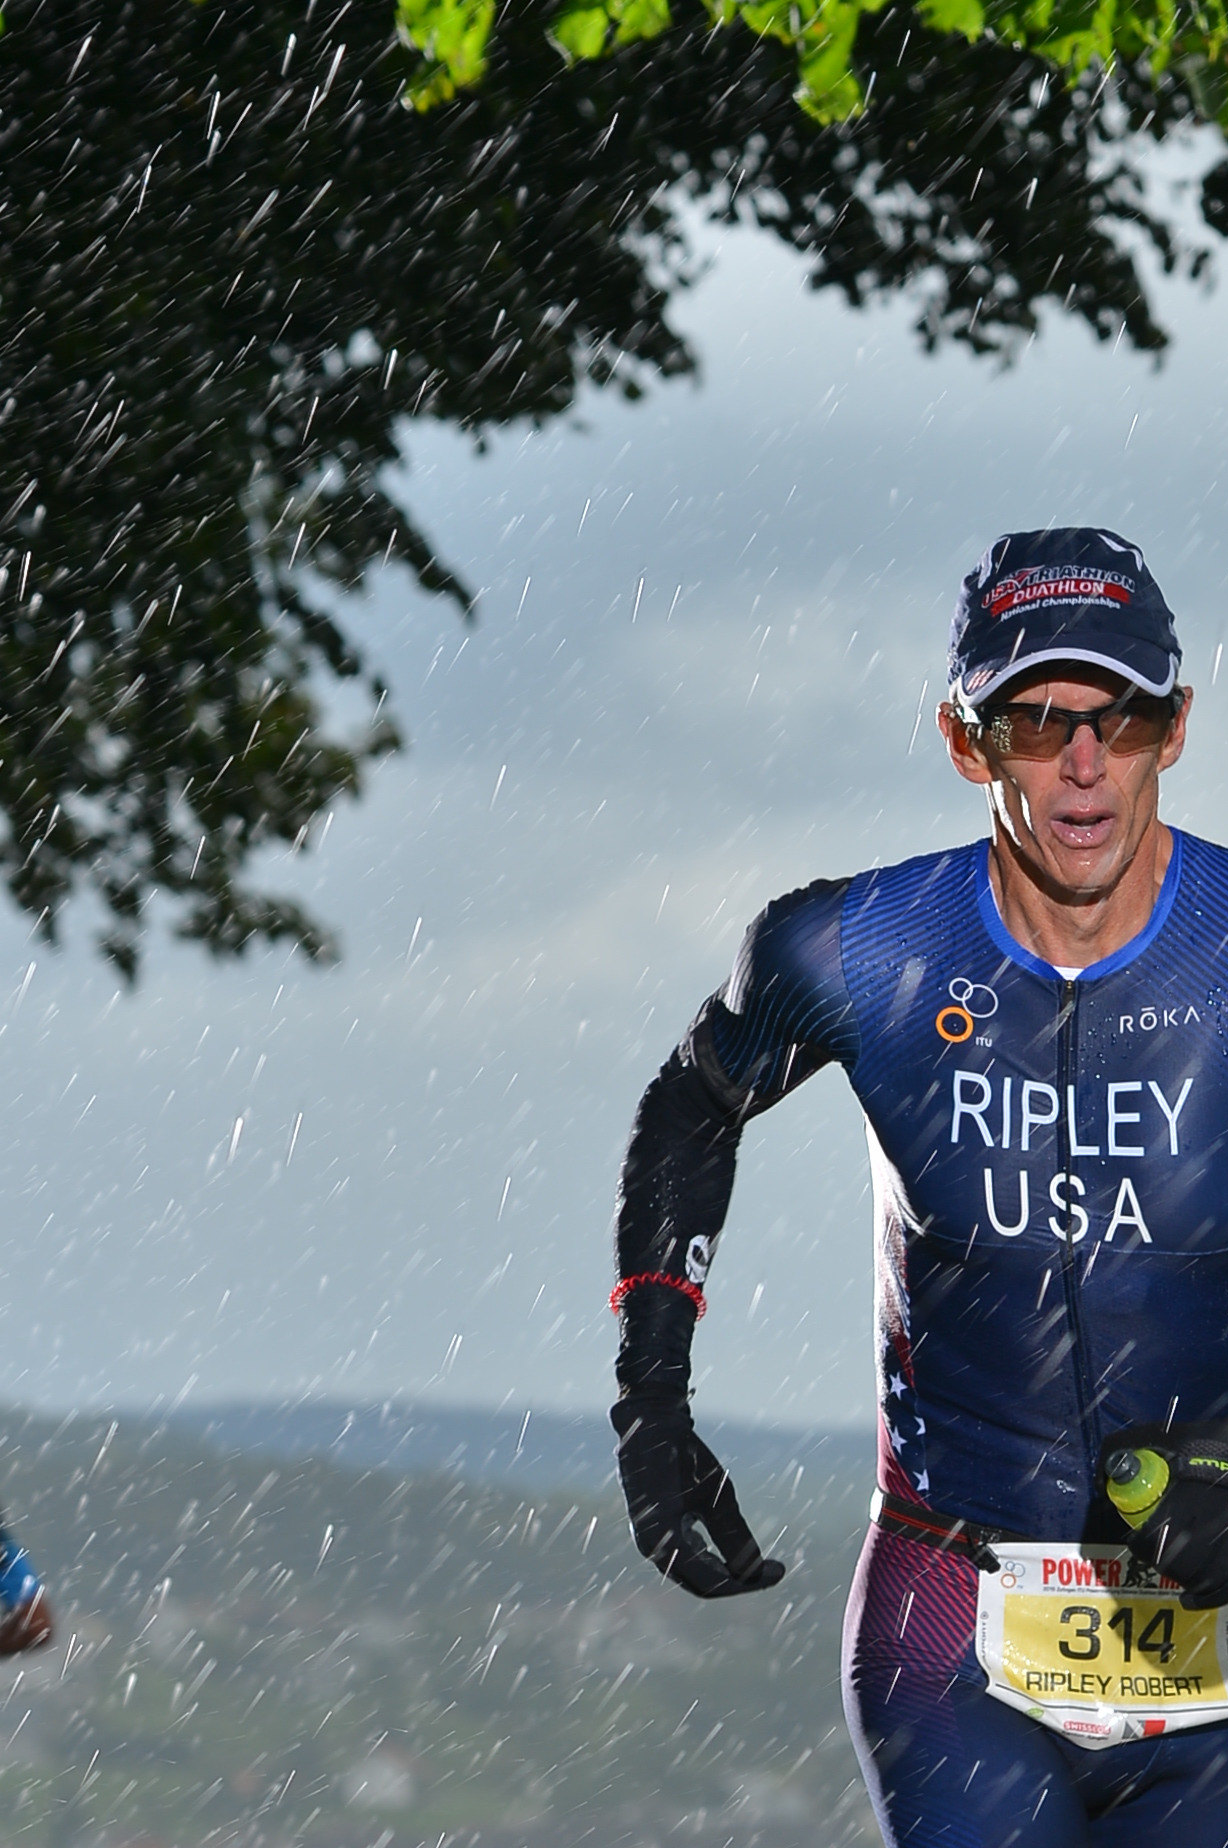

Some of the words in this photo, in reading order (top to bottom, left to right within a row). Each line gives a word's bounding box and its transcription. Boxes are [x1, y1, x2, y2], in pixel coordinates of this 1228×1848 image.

[1012, 580, 1105, 604] DUATHLON
[1026, 565, 1135, 593] TRIATHLON
[1000, 600, 1040, 622] National
[1042, 594, 1121, 609] Championships
[975, 1036, 993, 1047] ITU
[951, 1070, 1194, 1156] RIPLEY
[984, 1168, 1153, 1244] USA
[1042, 1557, 1122, 1588] POWER
[1058, 1605, 1175, 1664] 314
[1026, 1671, 1112, 1695] RIPLEY
[1120, 1676, 1203, 1697] ROBERT
